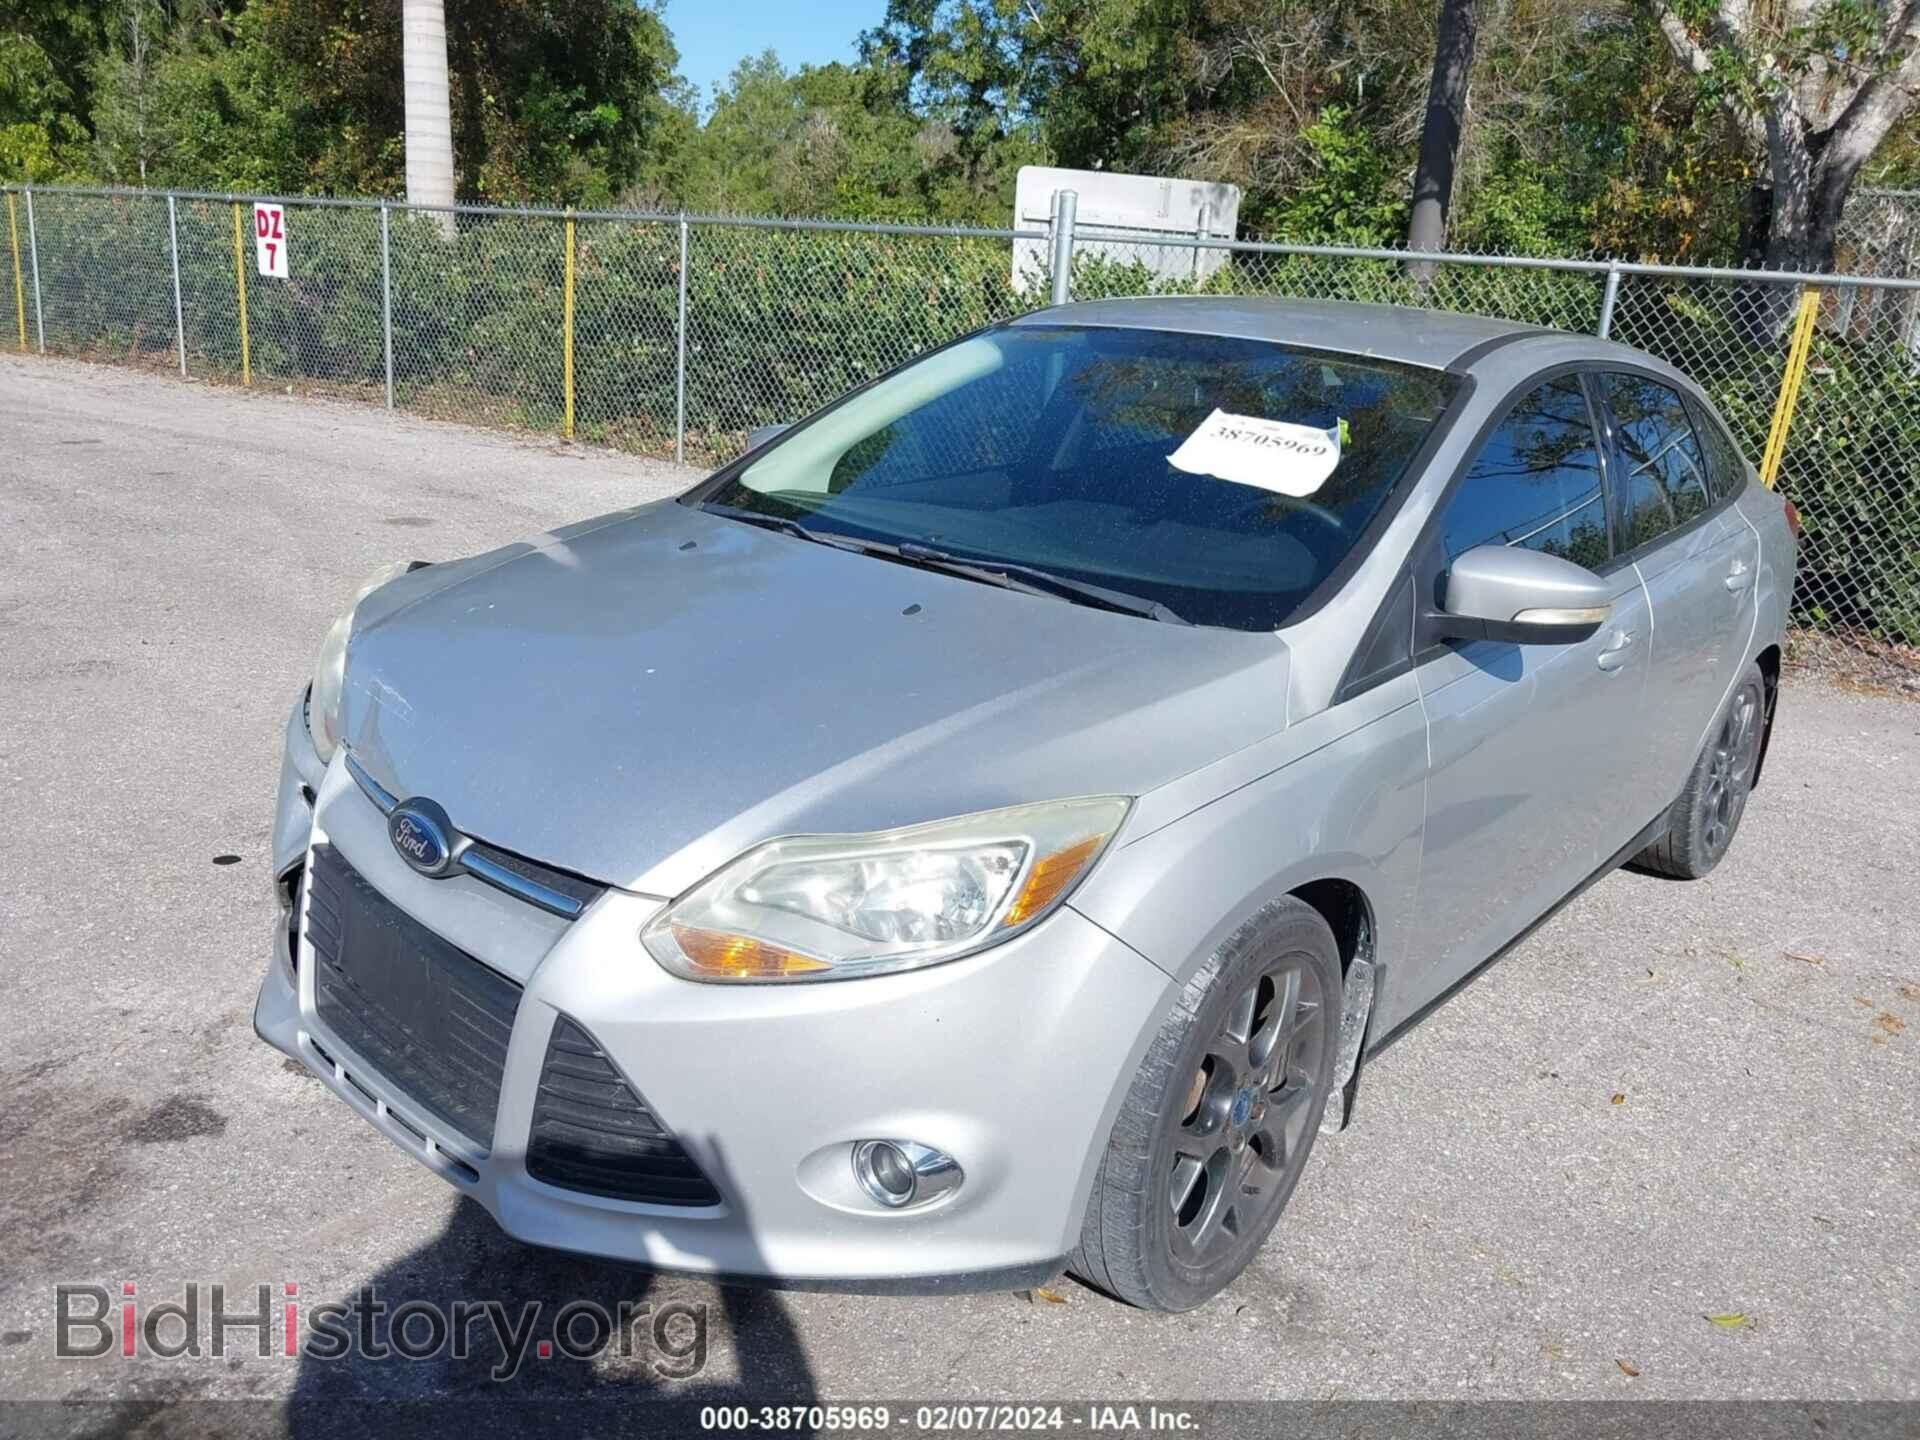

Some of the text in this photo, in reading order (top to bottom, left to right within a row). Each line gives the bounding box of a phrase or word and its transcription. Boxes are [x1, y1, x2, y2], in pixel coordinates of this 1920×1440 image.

[256, 209, 283, 239] DZ
[265, 243, 277, 270] 7
[1210, 426, 1328, 457] 38705969
[395, 818, 428, 858] Ford
